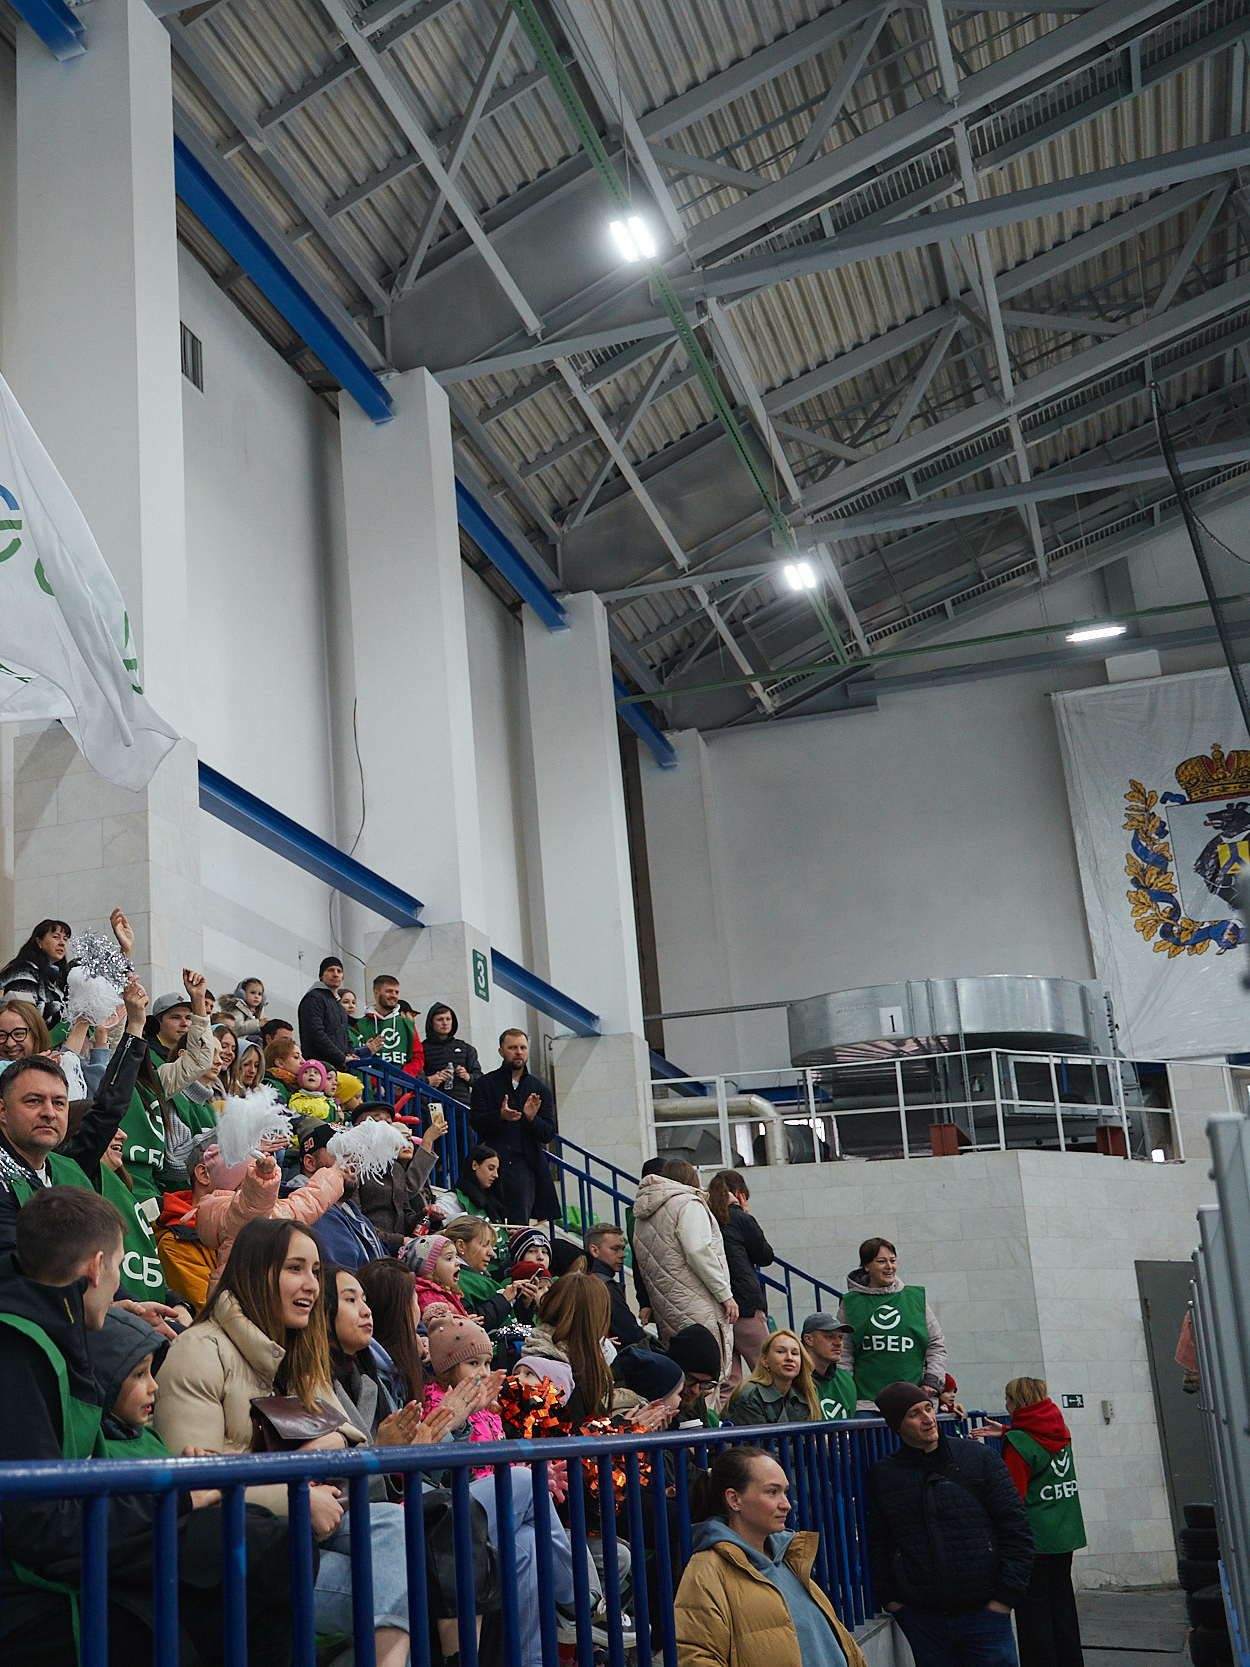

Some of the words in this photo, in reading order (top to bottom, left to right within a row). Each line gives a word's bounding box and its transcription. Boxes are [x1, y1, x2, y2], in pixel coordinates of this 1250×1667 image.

[477, 960, 486, 989] 3
[889, 1014, 897, 1033] 1
[862, 1335, 914, 1352] СБЕР
[1040, 1480, 1078, 1500] СБЕР
